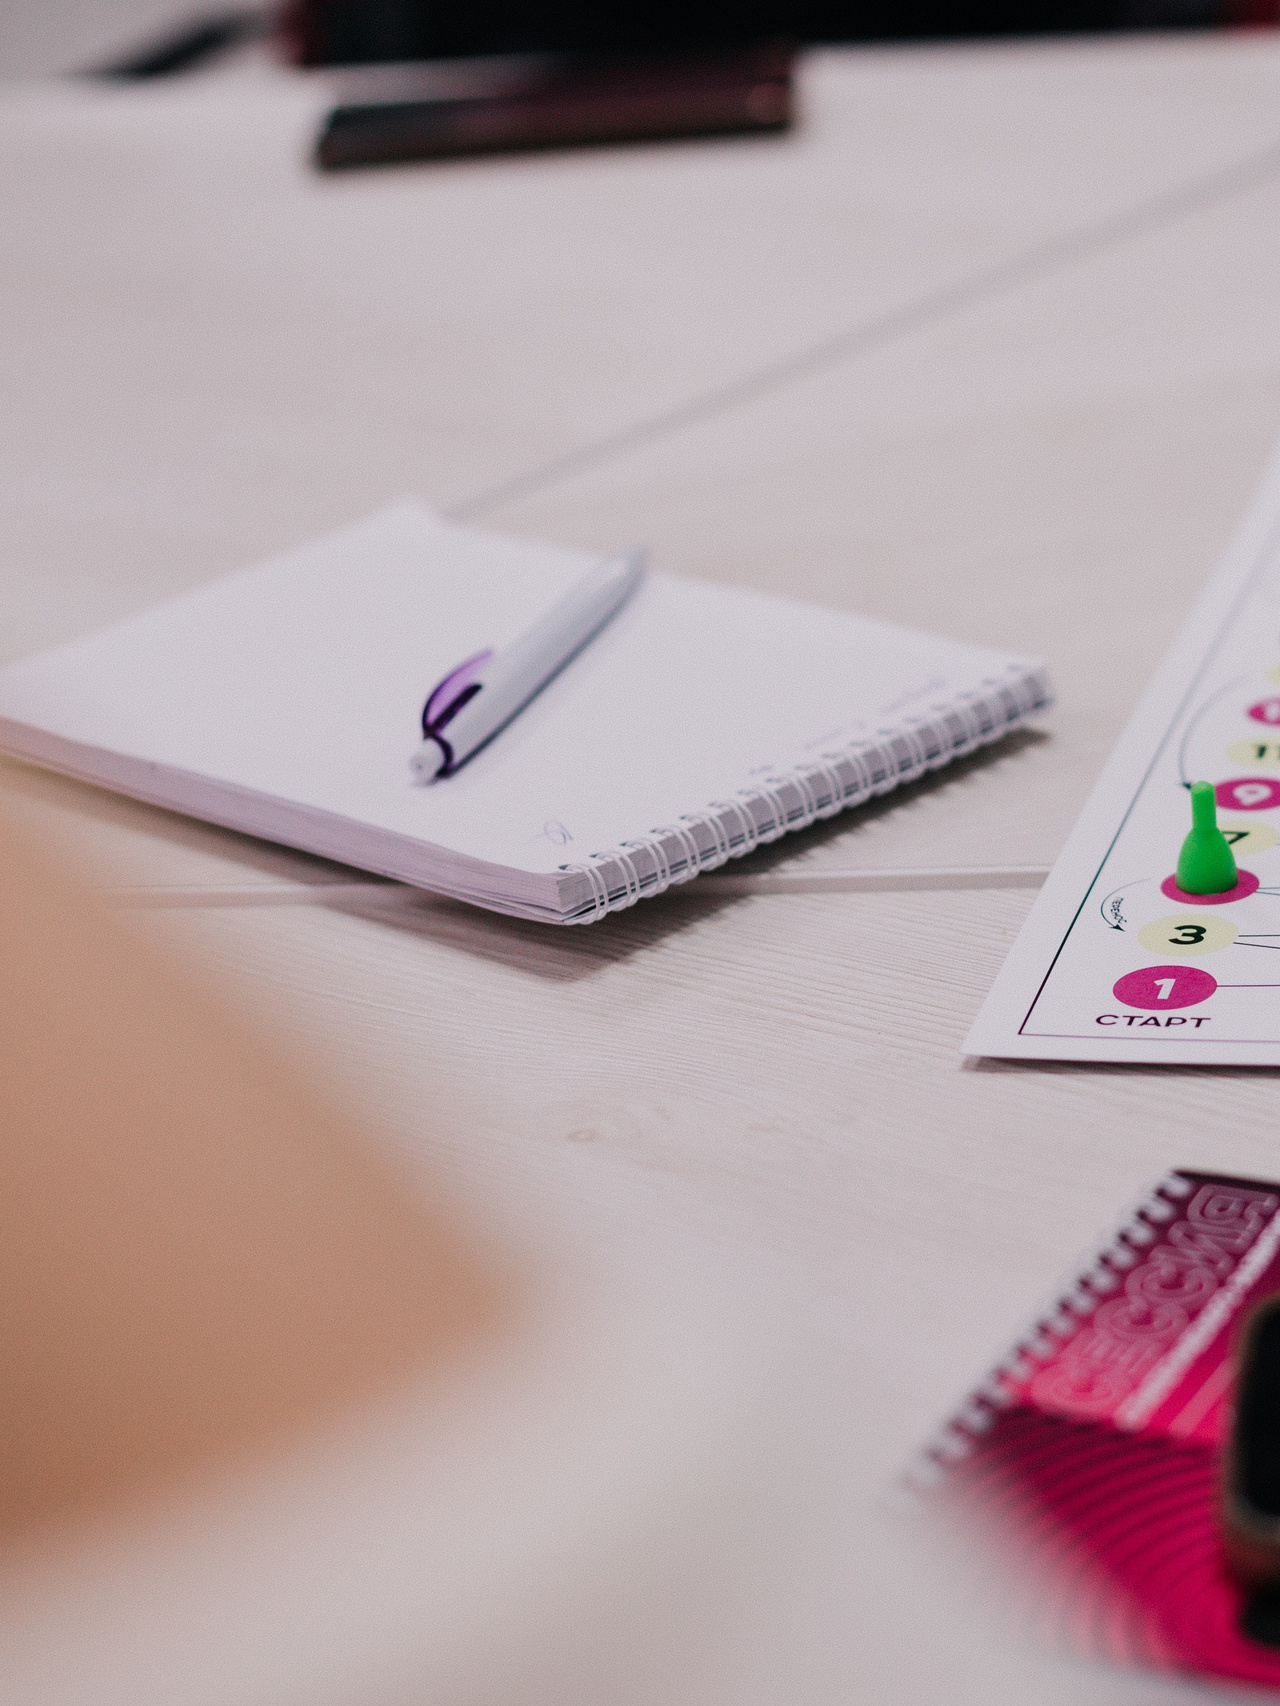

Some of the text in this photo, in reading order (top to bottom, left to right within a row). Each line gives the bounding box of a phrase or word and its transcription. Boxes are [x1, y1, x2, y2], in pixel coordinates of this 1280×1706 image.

[1231, 782, 1273, 806] 9
[1167, 924, 1208, 946] 3
[1152, 977, 1177, 1001] 1
[1095, 1013, 1212, 1029] СТАРТ
